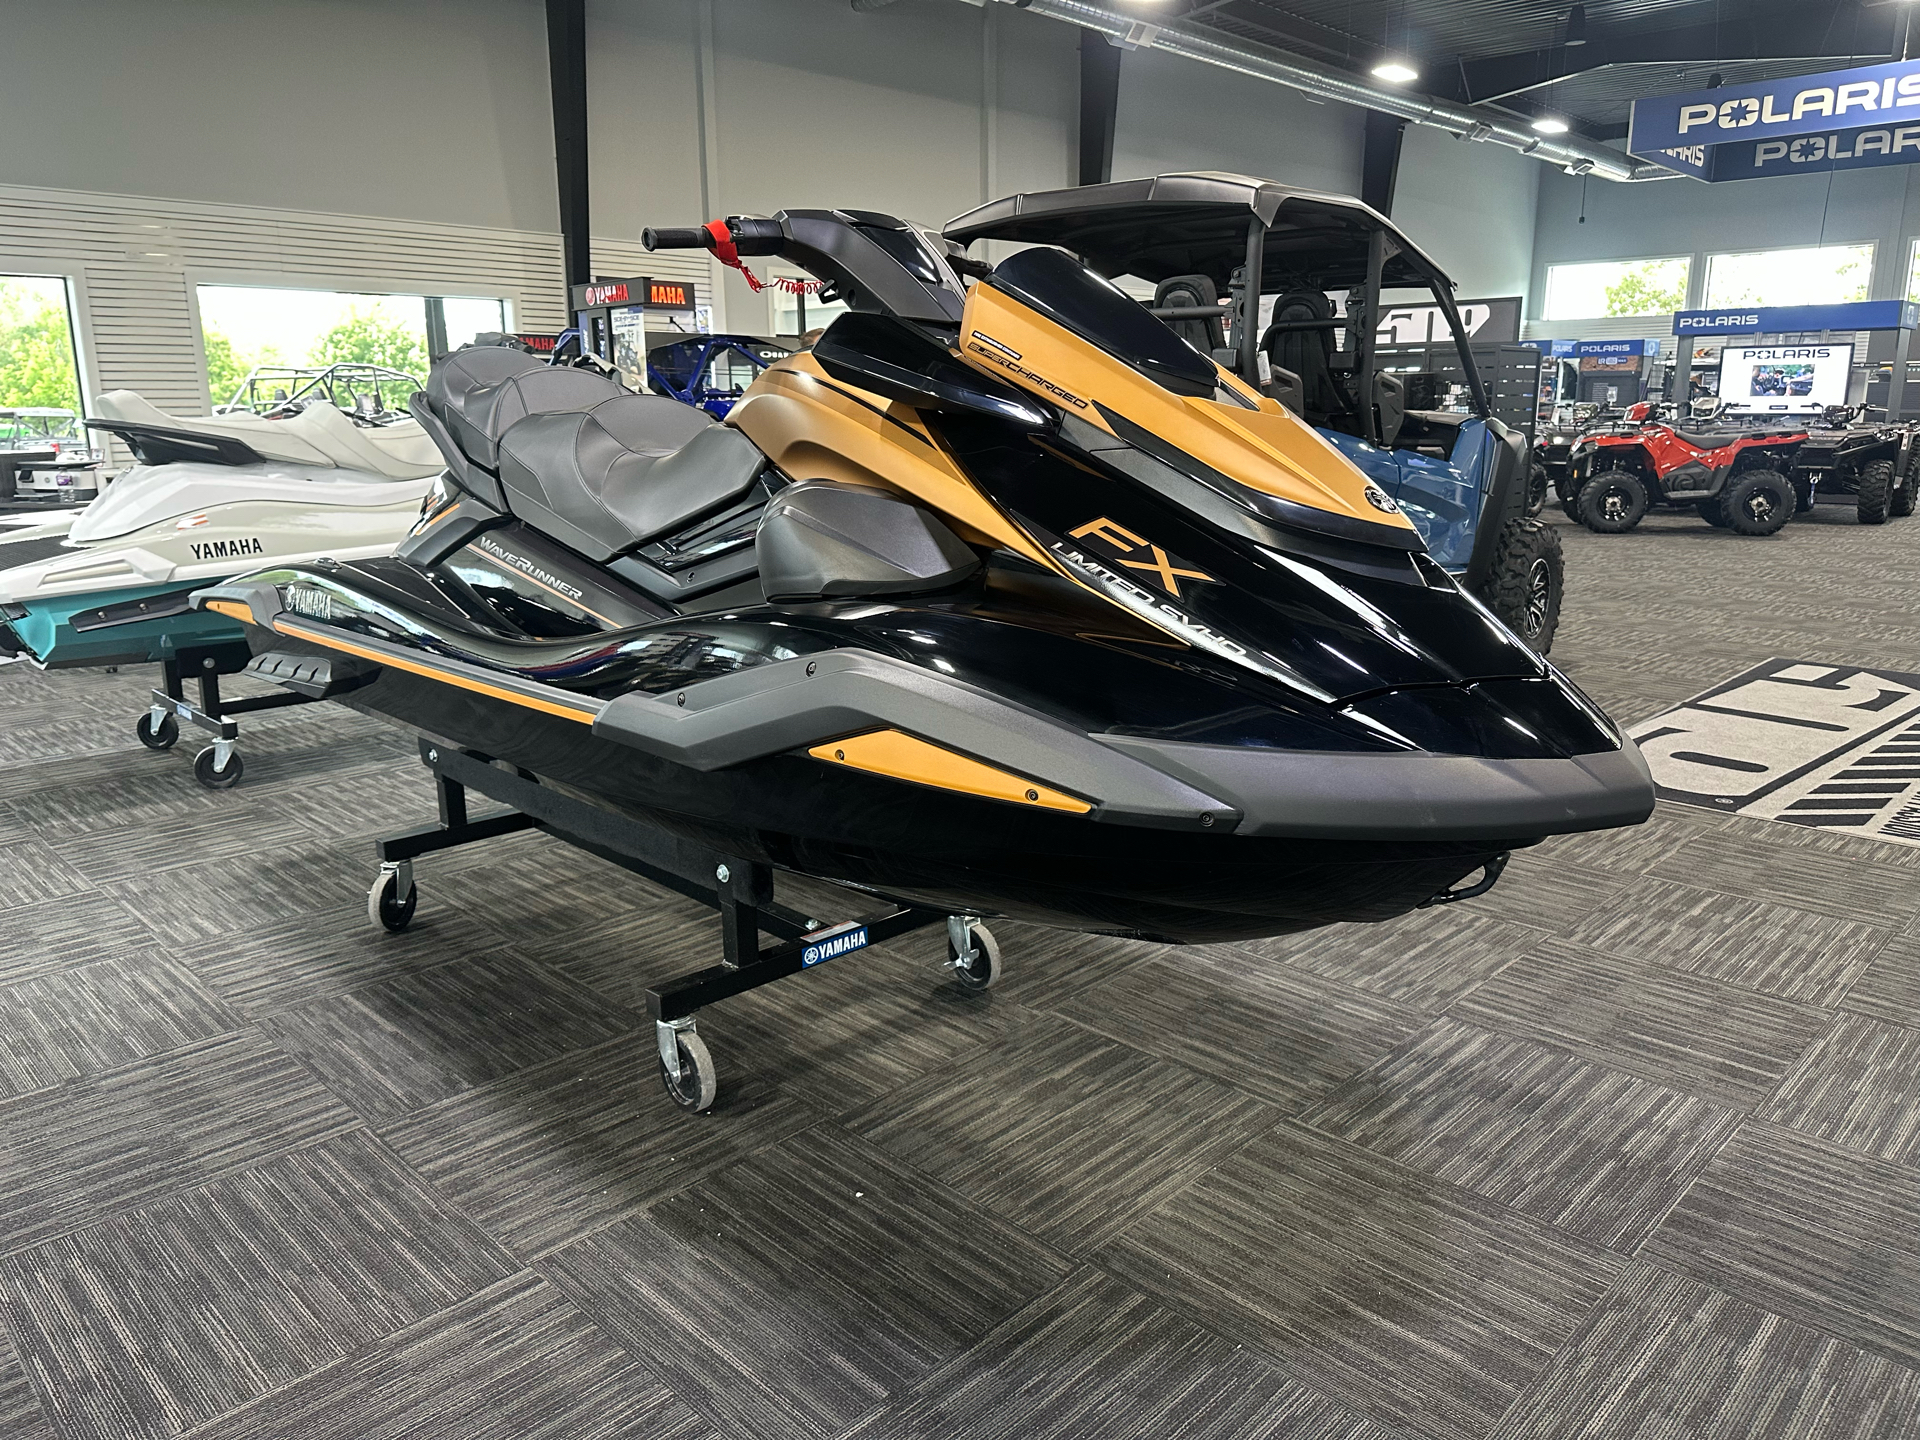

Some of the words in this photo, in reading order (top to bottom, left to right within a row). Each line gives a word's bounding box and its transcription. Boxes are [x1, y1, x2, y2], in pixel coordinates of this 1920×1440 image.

[1678, 73, 1920, 134] POLARIS
[594, 284, 629, 305] YAMAHA
[1679, 314, 1759, 329] POLARIS
[1580, 343, 1630, 353] POLARIS
[1743, 348, 1831, 360] POLARIS
[967, 342, 1089, 410] SUPERCHARGED
[190, 537, 264, 560] YAMAHA
[1067, 516, 1218, 599] FX
[295, 587, 332, 620] YAMAHA
[1050, 541, 1156, 604] LIMITED
[1158, 603, 1248, 657] SVHO
[818, 930, 867, 960] YAMAHA
